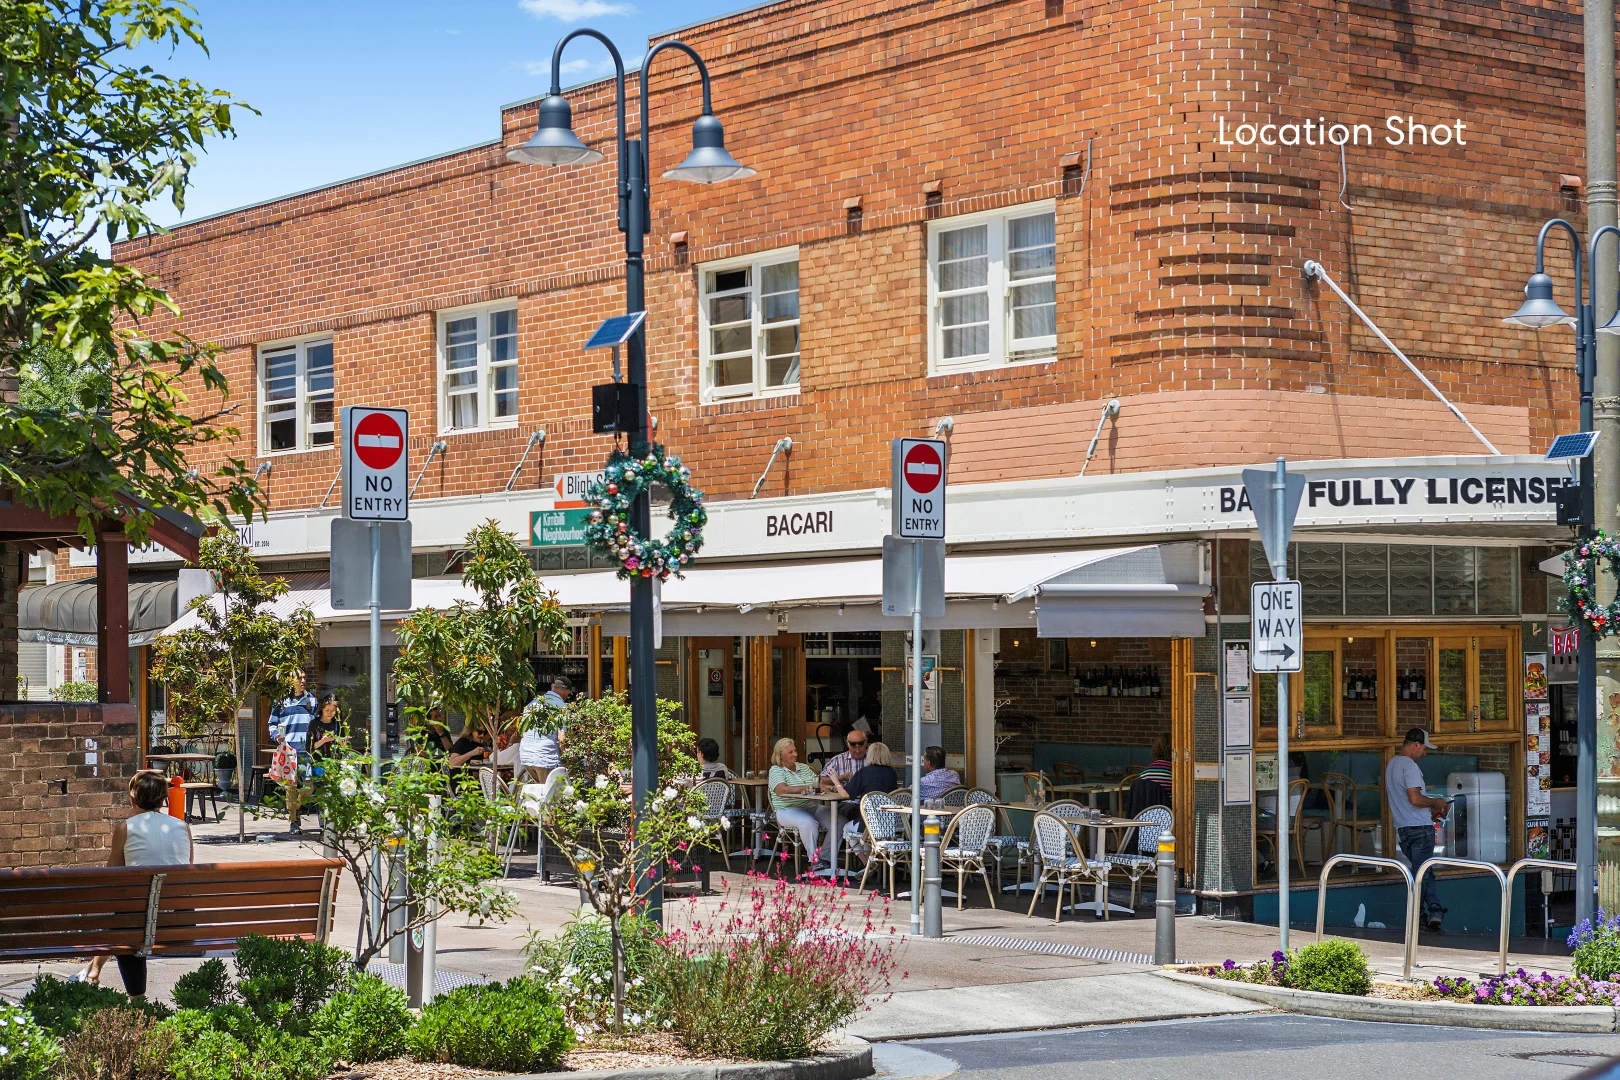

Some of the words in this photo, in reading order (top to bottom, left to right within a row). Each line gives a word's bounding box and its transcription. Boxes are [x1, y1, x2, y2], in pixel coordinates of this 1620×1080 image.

[365, 475, 393, 492] NO
[567, 475, 593, 496] Bligh
[355, 497, 403, 512] ENTRY
[1220, 486, 1253, 513] BA
[1308, 478, 1416, 507] FULLY
[912, 498, 933, 514] NO
[766, 510, 833, 537] BACARI
[905, 518, 939, 531] ENTRY
[1260, 590, 1293, 611] ONE
[1258, 618, 1296, 638] WAY
[1552, 629, 1579, 655] BAT
